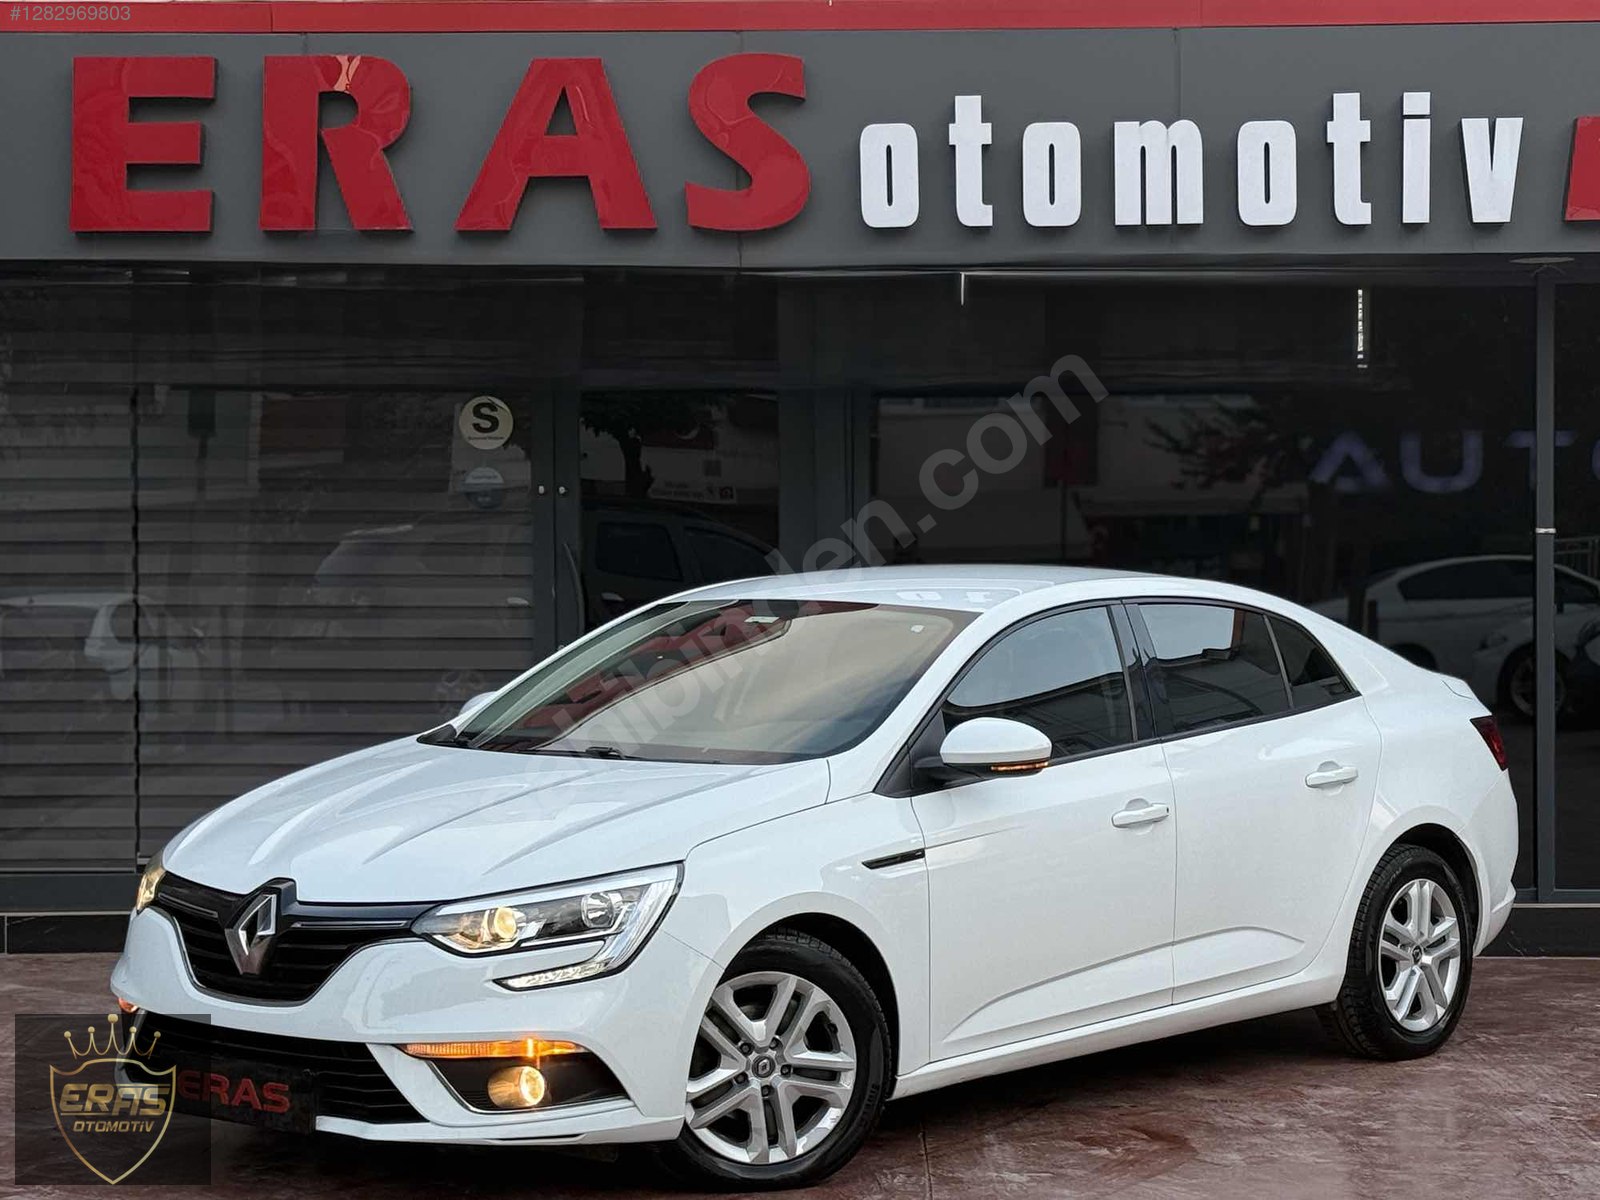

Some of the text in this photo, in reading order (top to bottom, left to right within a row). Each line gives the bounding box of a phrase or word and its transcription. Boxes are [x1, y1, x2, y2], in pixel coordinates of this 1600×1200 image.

[70, 53, 1524, 233] ERAS otomotiv
[472, 402, 499, 434] S
[1309, 428, 1600, 494] AUT
[177, 1070, 291, 1113] ERAS
